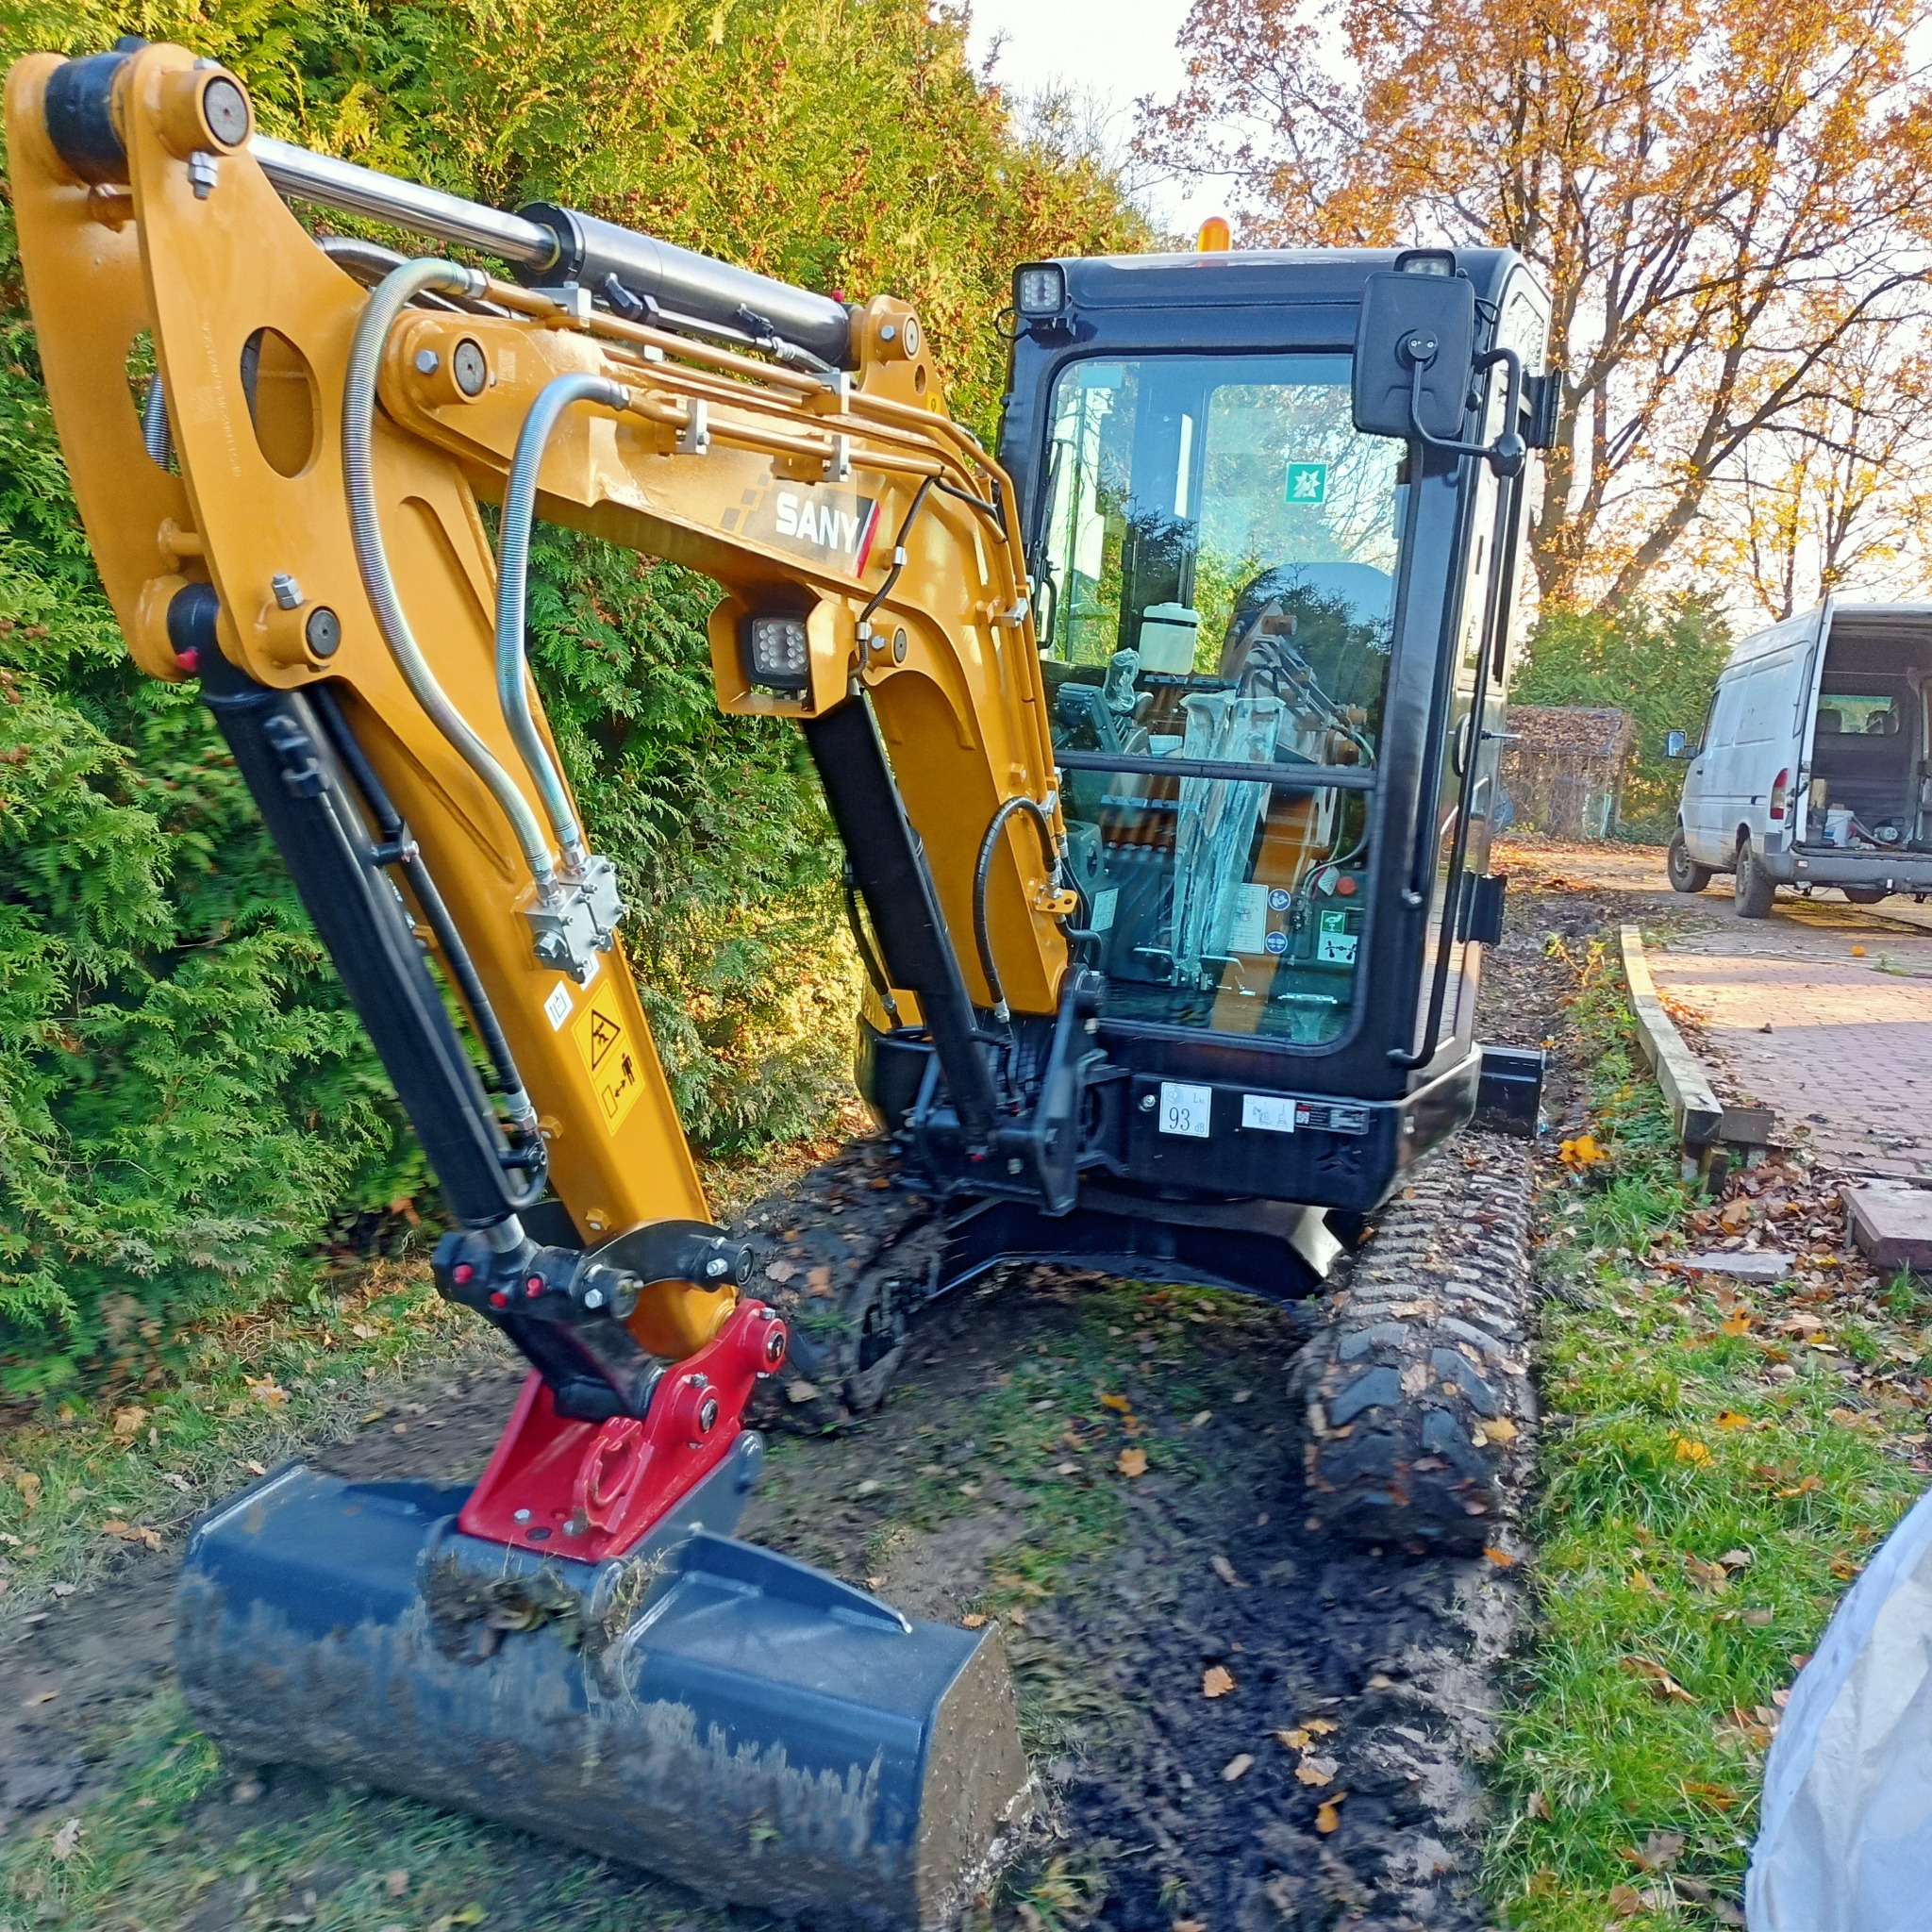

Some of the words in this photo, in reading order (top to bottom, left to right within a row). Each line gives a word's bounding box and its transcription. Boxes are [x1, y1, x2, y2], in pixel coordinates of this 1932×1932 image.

[775, 491, 860, 554] SANY
[1169, 1107, 1191, 1131] 93
[1194, 1122, 1206, 1133] dB
